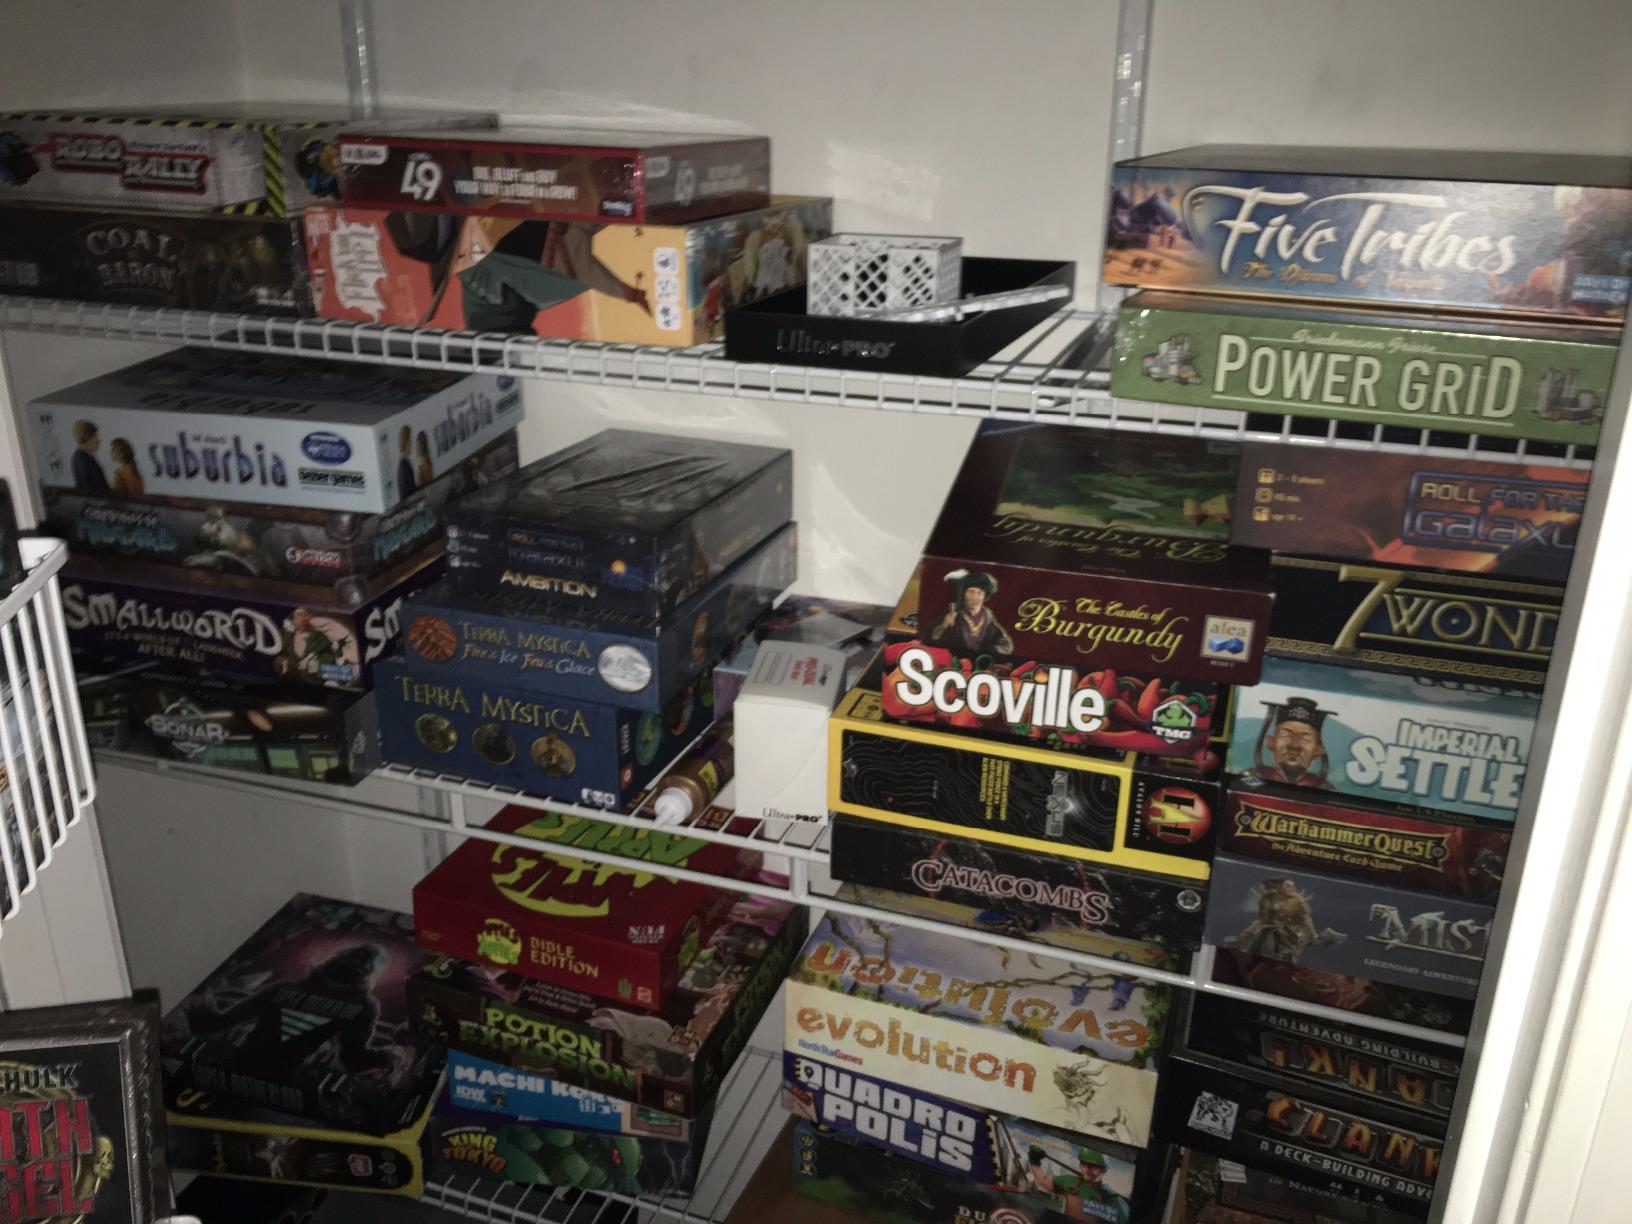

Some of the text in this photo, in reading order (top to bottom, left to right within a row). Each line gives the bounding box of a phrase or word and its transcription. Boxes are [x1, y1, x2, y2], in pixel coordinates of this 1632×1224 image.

[123, 155, 209, 183] RALLY
[401, 159, 443, 201] 49
[86, 227, 179, 262] COAL
[1184, 184, 1517, 281] Five Tribes
[1213, 333, 1525, 420] POWER GRID
[149, 430, 288, 488] suburbia
[1420, 481, 1482, 504] ROLL
[1490, 487, 1537, 508] FOR
[500, 568, 598, 599] AMBITION
[1014, 597, 1190, 663] Burgundy
[1074, 597, 1173, 625] The Castles of
[1210, 620, 1247, 637] alea
[1338, 564, 1404, 650] 7
[459, 620, 592, 660] TERRA MYSTICA
[555, 658, 596, 676] Glace
[896, 647, 1106, 733] Scoville
[394, 675, 592, 738] TERRA MYSTICA
[1152, 726, 1192, 740] TMG
[1398, 718, 1520, 764] IMPERIAL
[1250, 809, 1435, 860] Warhammer Quest
[911, 858, 1110, 924] CATACOMBS
[530, 935, 576, 960] BIBLE
[530, 949, 600, 978] EDITION
[806, 941, 1150, 1049] evolution
[457, 1019, 636, 1091] EXPLOSION
[485, 1006, 604, 1059] POTION
[796, 1005, 1037, 1093] evolution
[3, 1061, 82, 1092] HULK
[454, 1064, 546, 1094] MACHI
[795, 1060, 977, 1144] QUADRO
[448, 1131, 498, 1154] KING
[822, 1092, 973, 1173] POLIS
[443, 1145, 507, 1175] TOKYO
[1273, 1142, 1391, 1188] DECK-BUILDING
